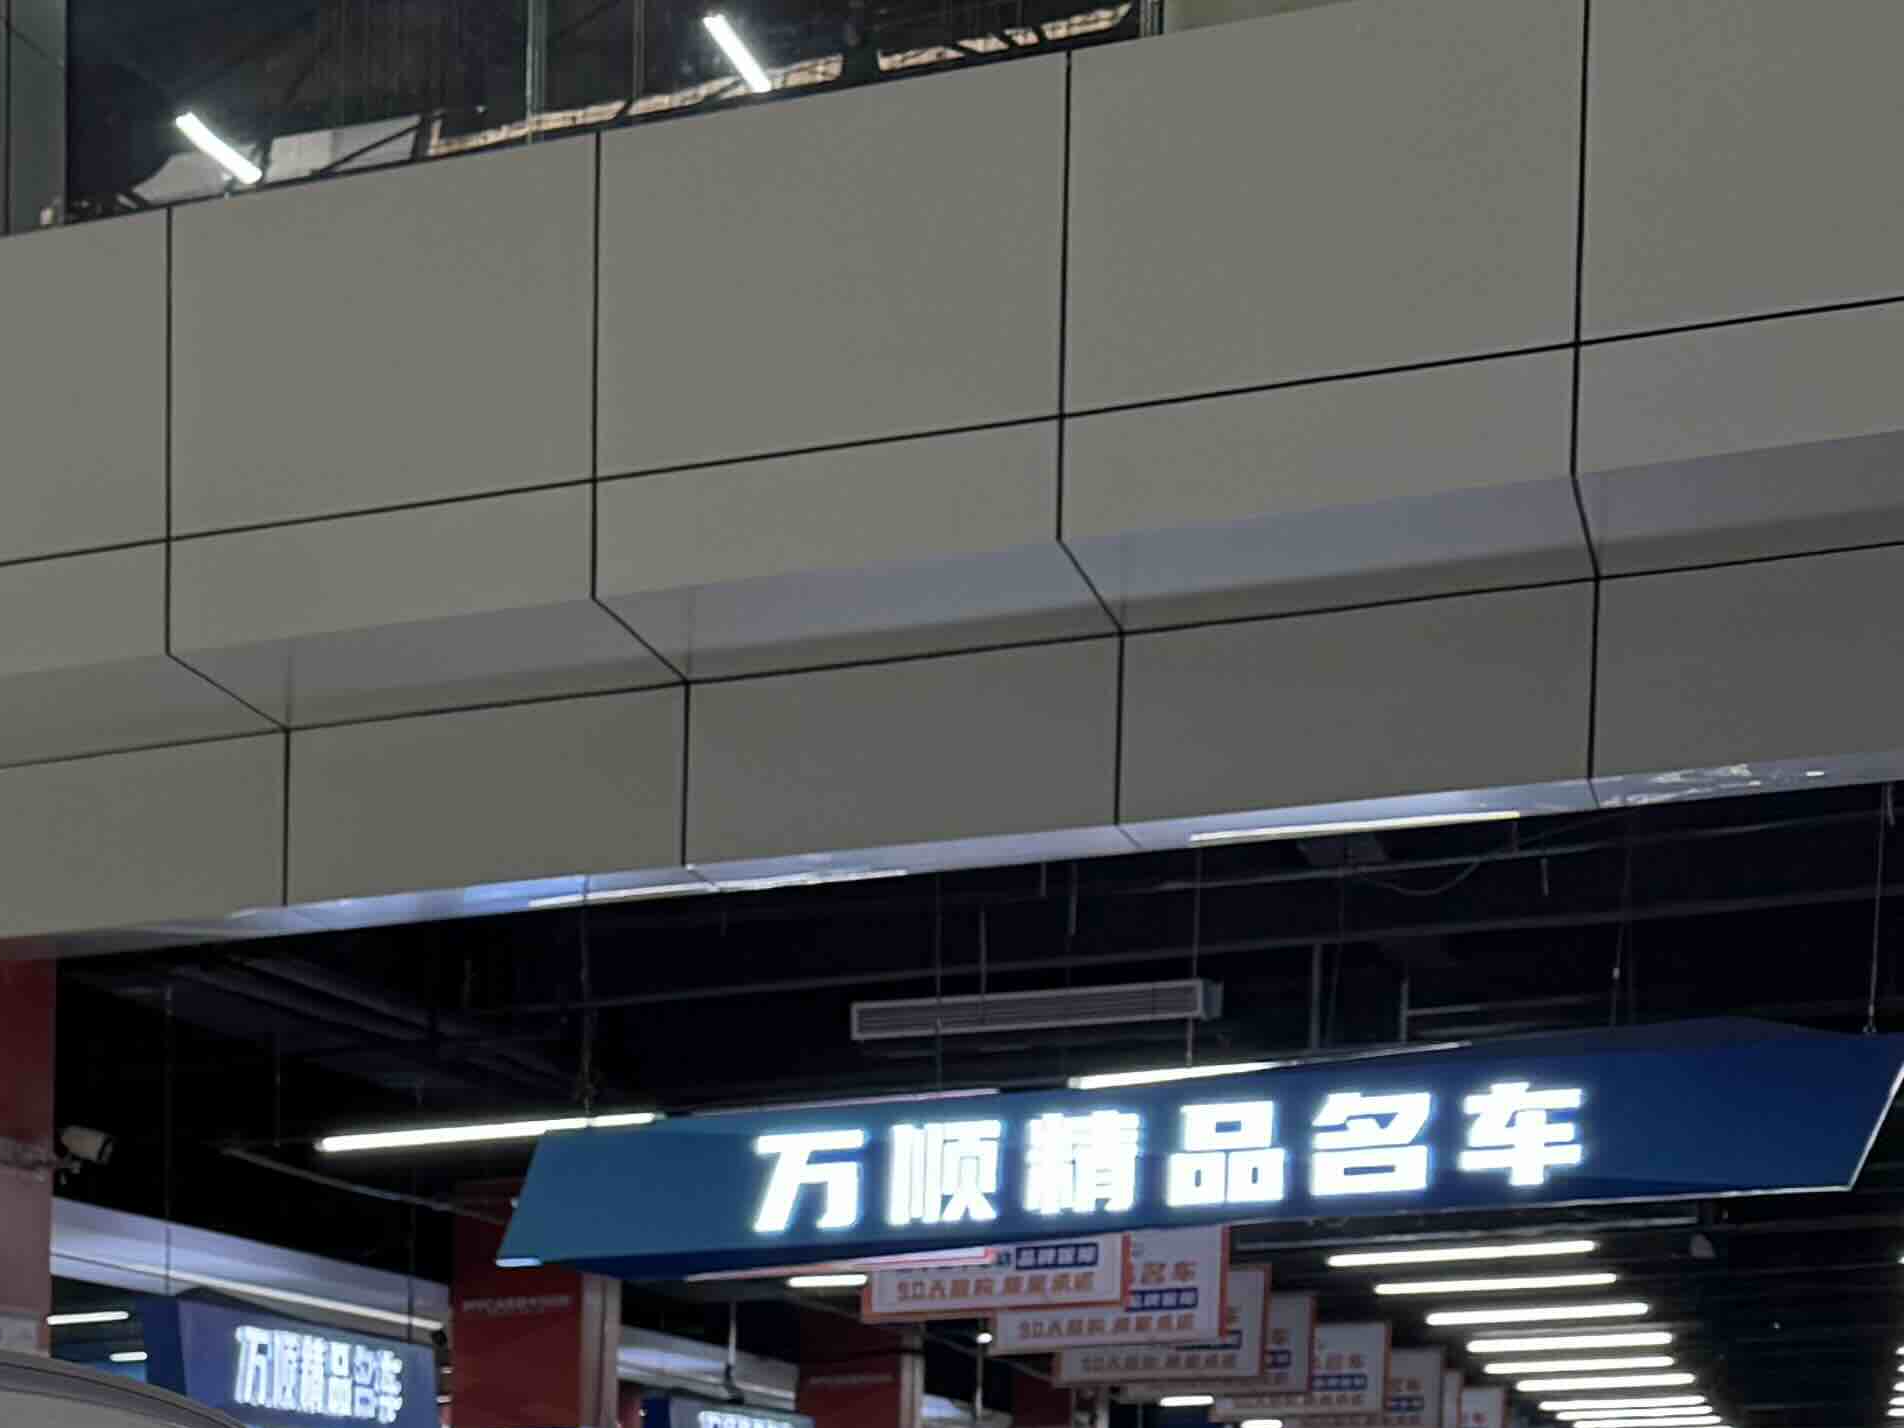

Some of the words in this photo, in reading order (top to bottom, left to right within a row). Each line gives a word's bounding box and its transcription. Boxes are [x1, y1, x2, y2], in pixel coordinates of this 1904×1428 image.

[752, 1082, 1583, 1233] 万顺精品名车
